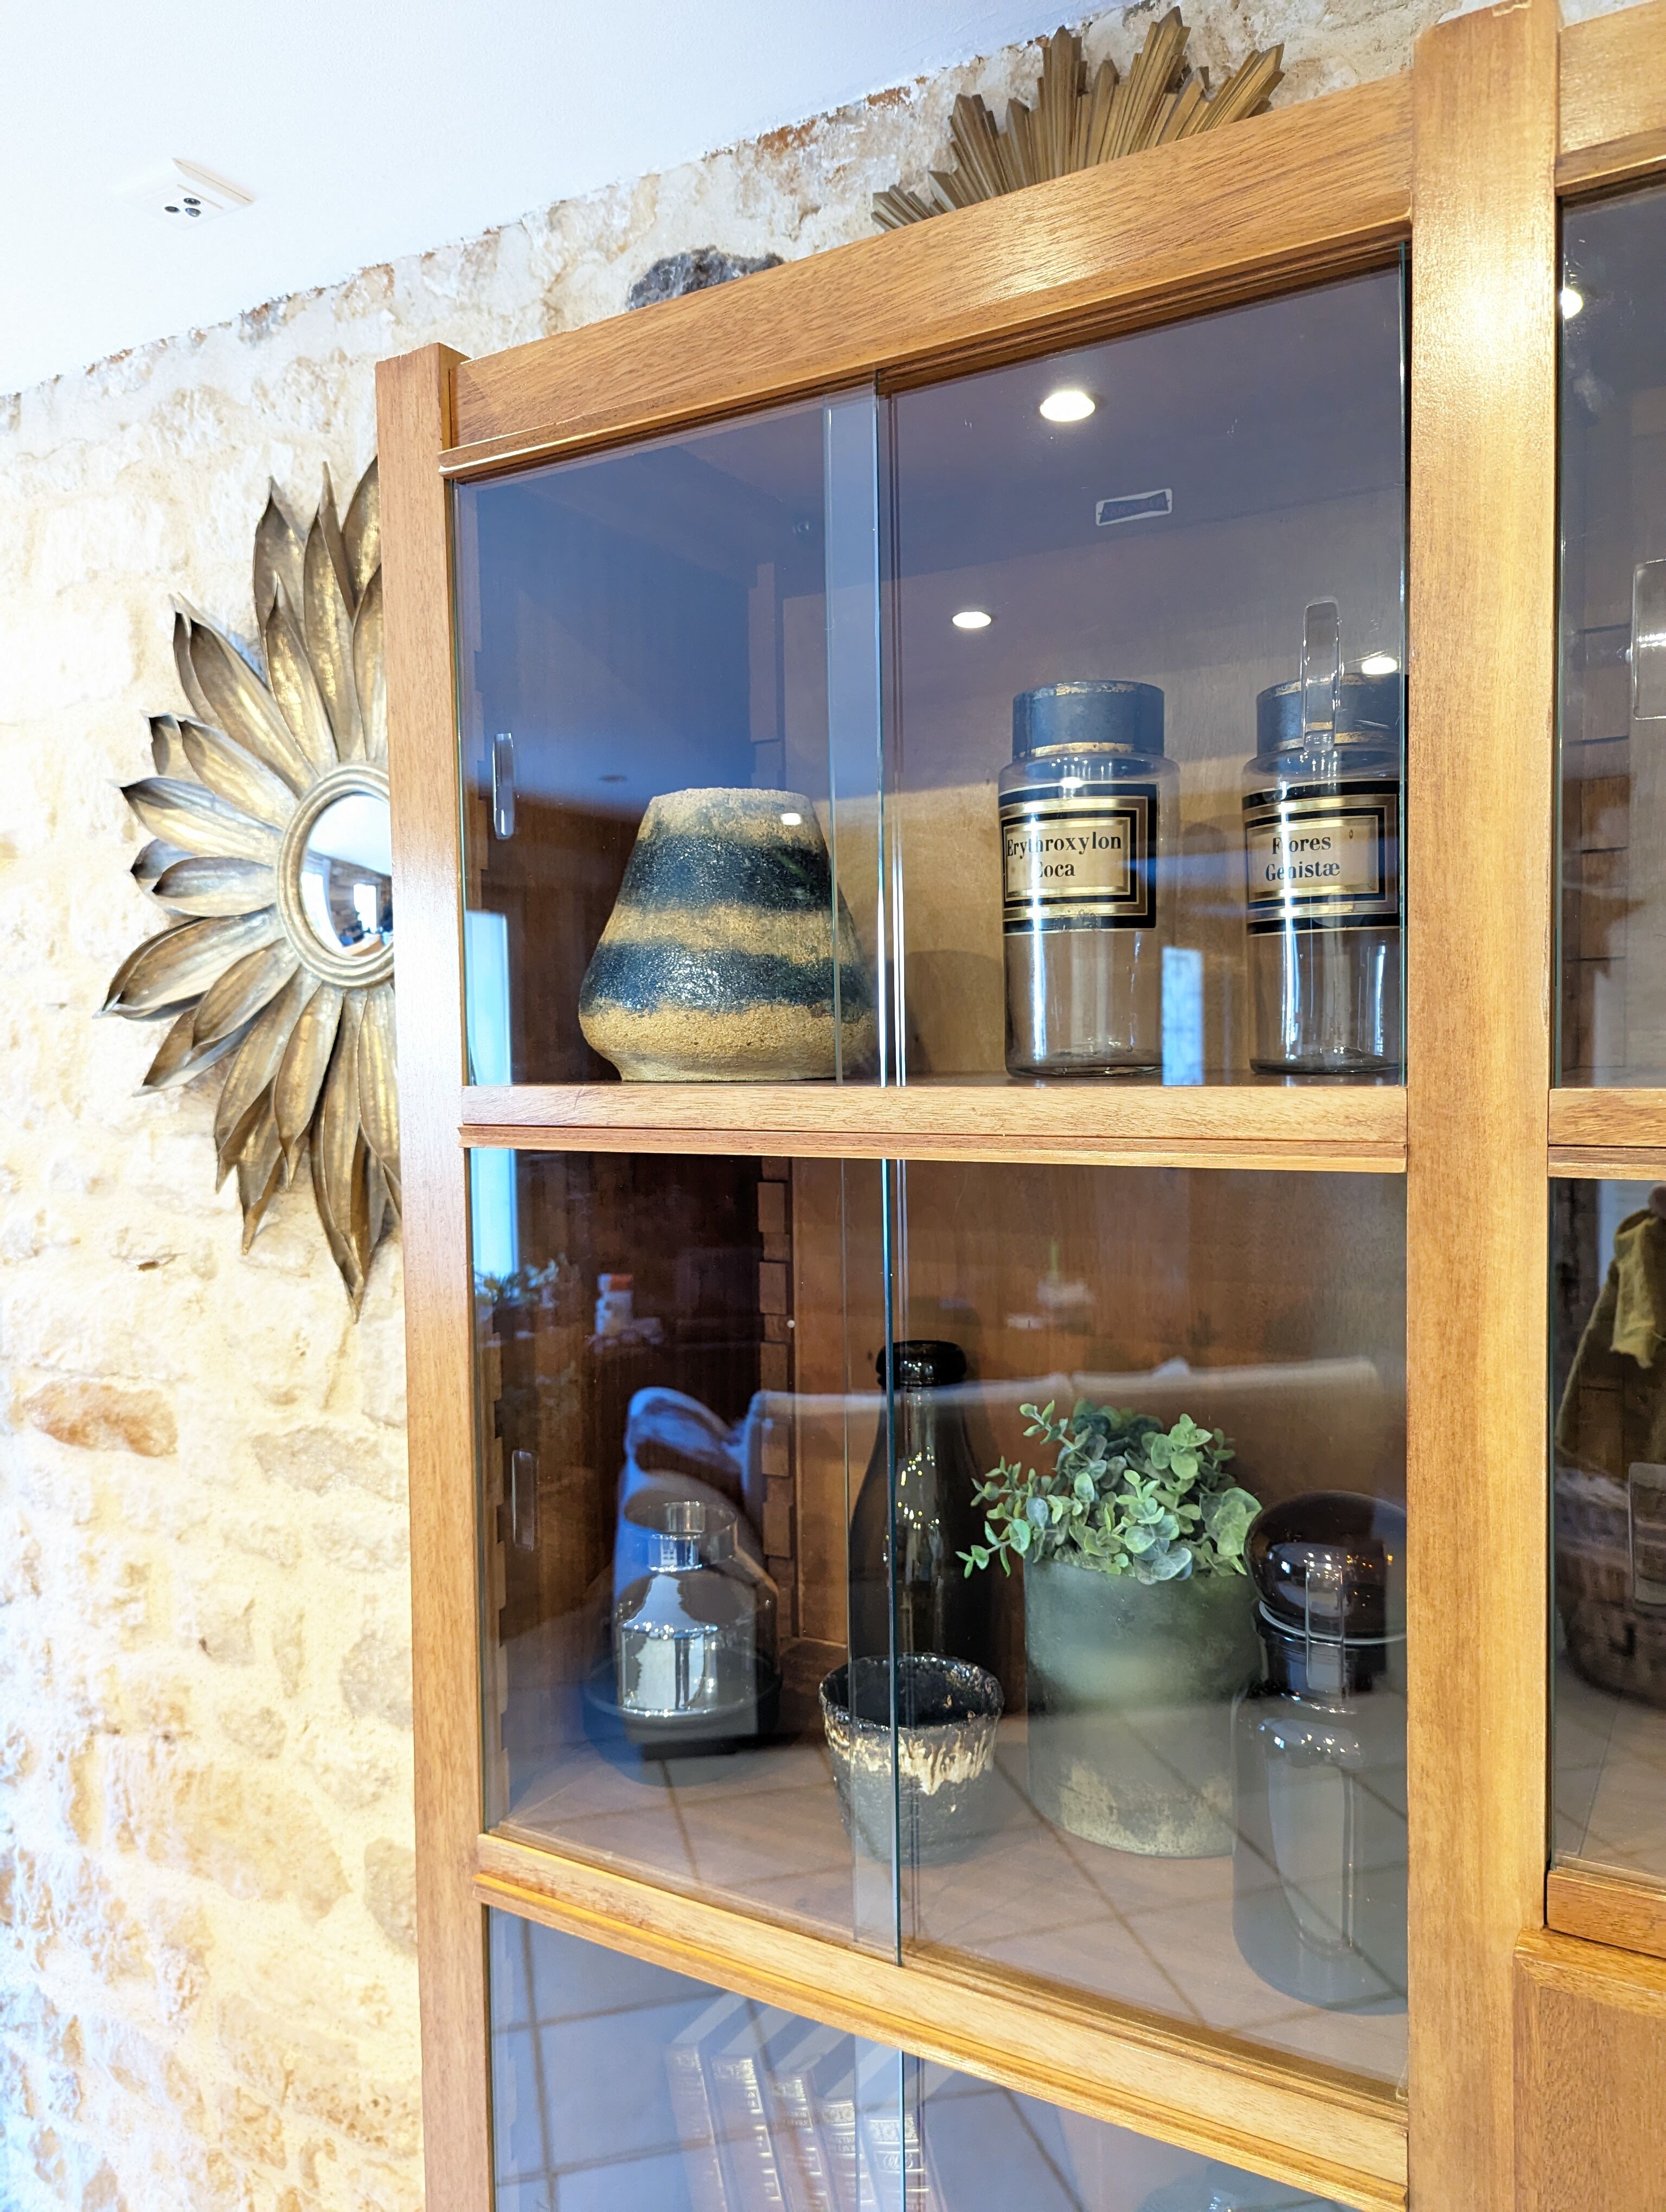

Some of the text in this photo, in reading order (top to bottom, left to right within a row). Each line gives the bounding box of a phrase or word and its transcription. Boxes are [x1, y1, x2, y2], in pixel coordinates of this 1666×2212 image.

[1007, 831, 1122, 860] Erythroxylon
[1272, 836, 1332, 855] Fores
[1265, 861, 1341, 882] Genistæ
